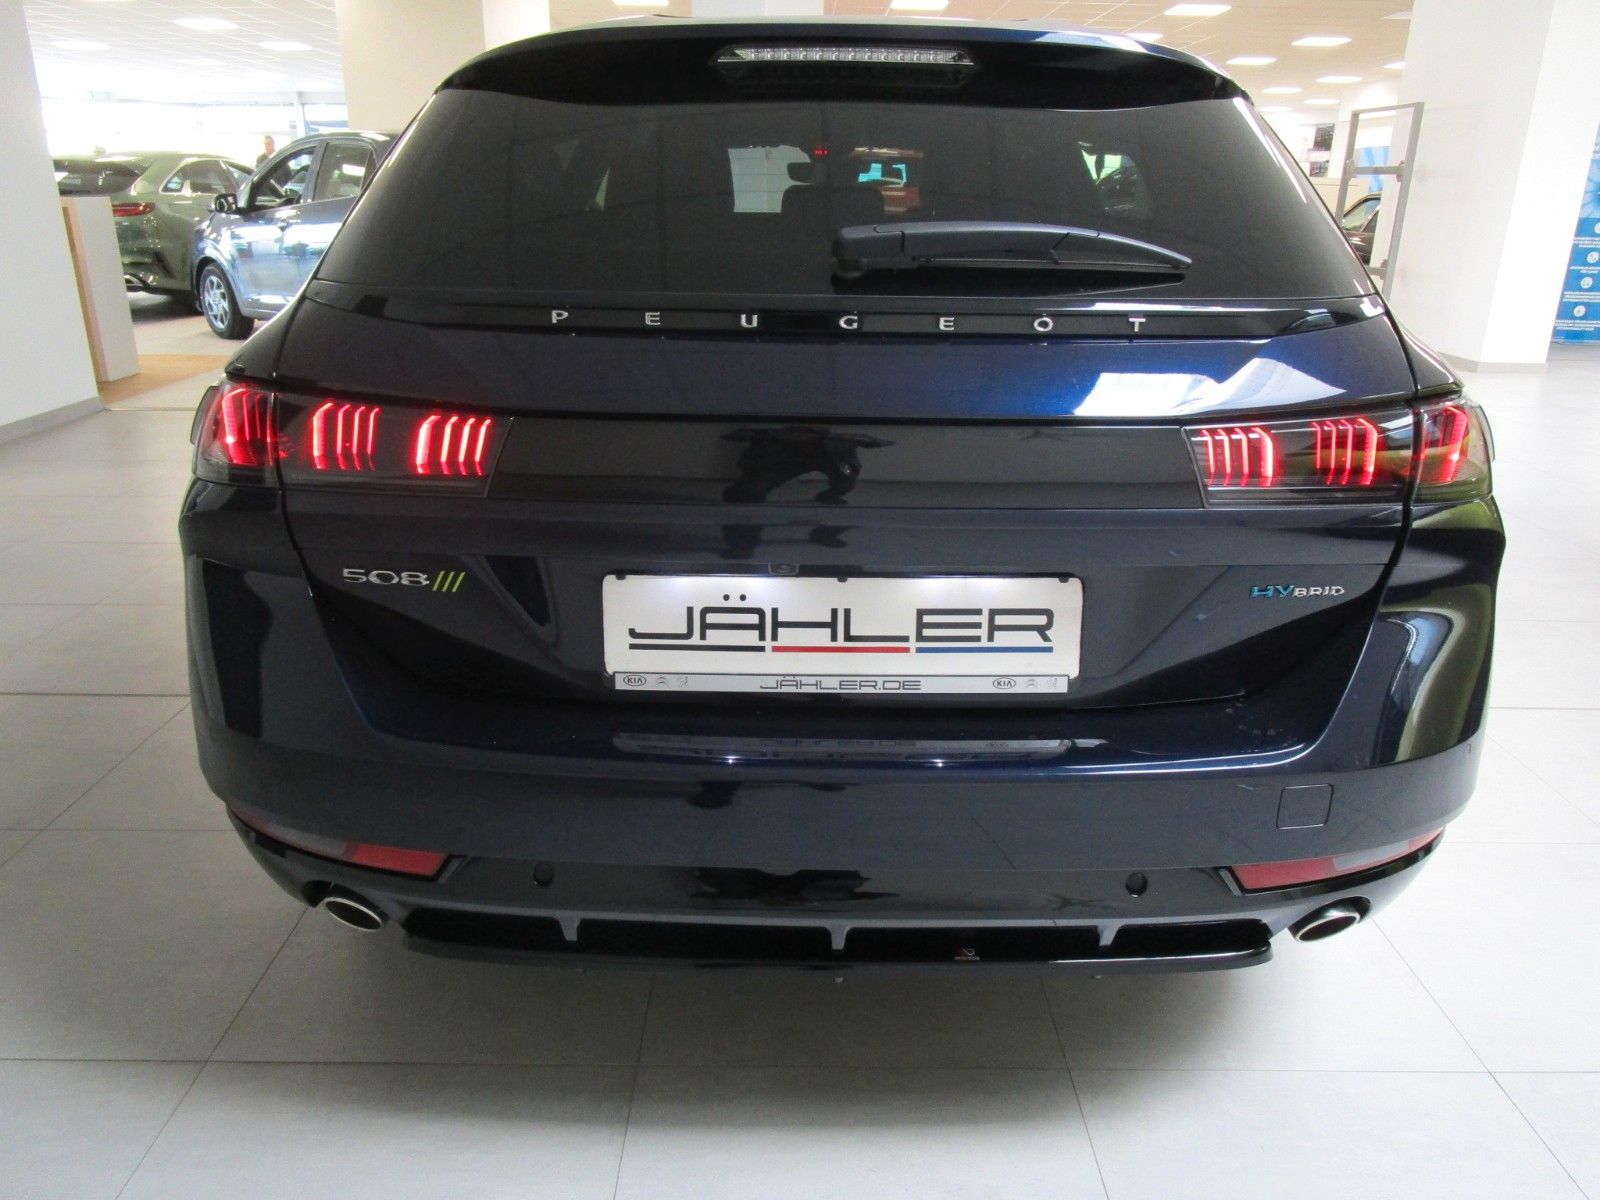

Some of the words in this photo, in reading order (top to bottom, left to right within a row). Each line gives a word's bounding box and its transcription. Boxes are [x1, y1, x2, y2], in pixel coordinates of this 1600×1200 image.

[551, 310, 1146, 332] PEUGEOT
[1251, 584, 1345, 598] HYBRID
[628, 594, 1055, 643] JÄHLER
[760, 676, 922, 690] JÄHLER.DE
